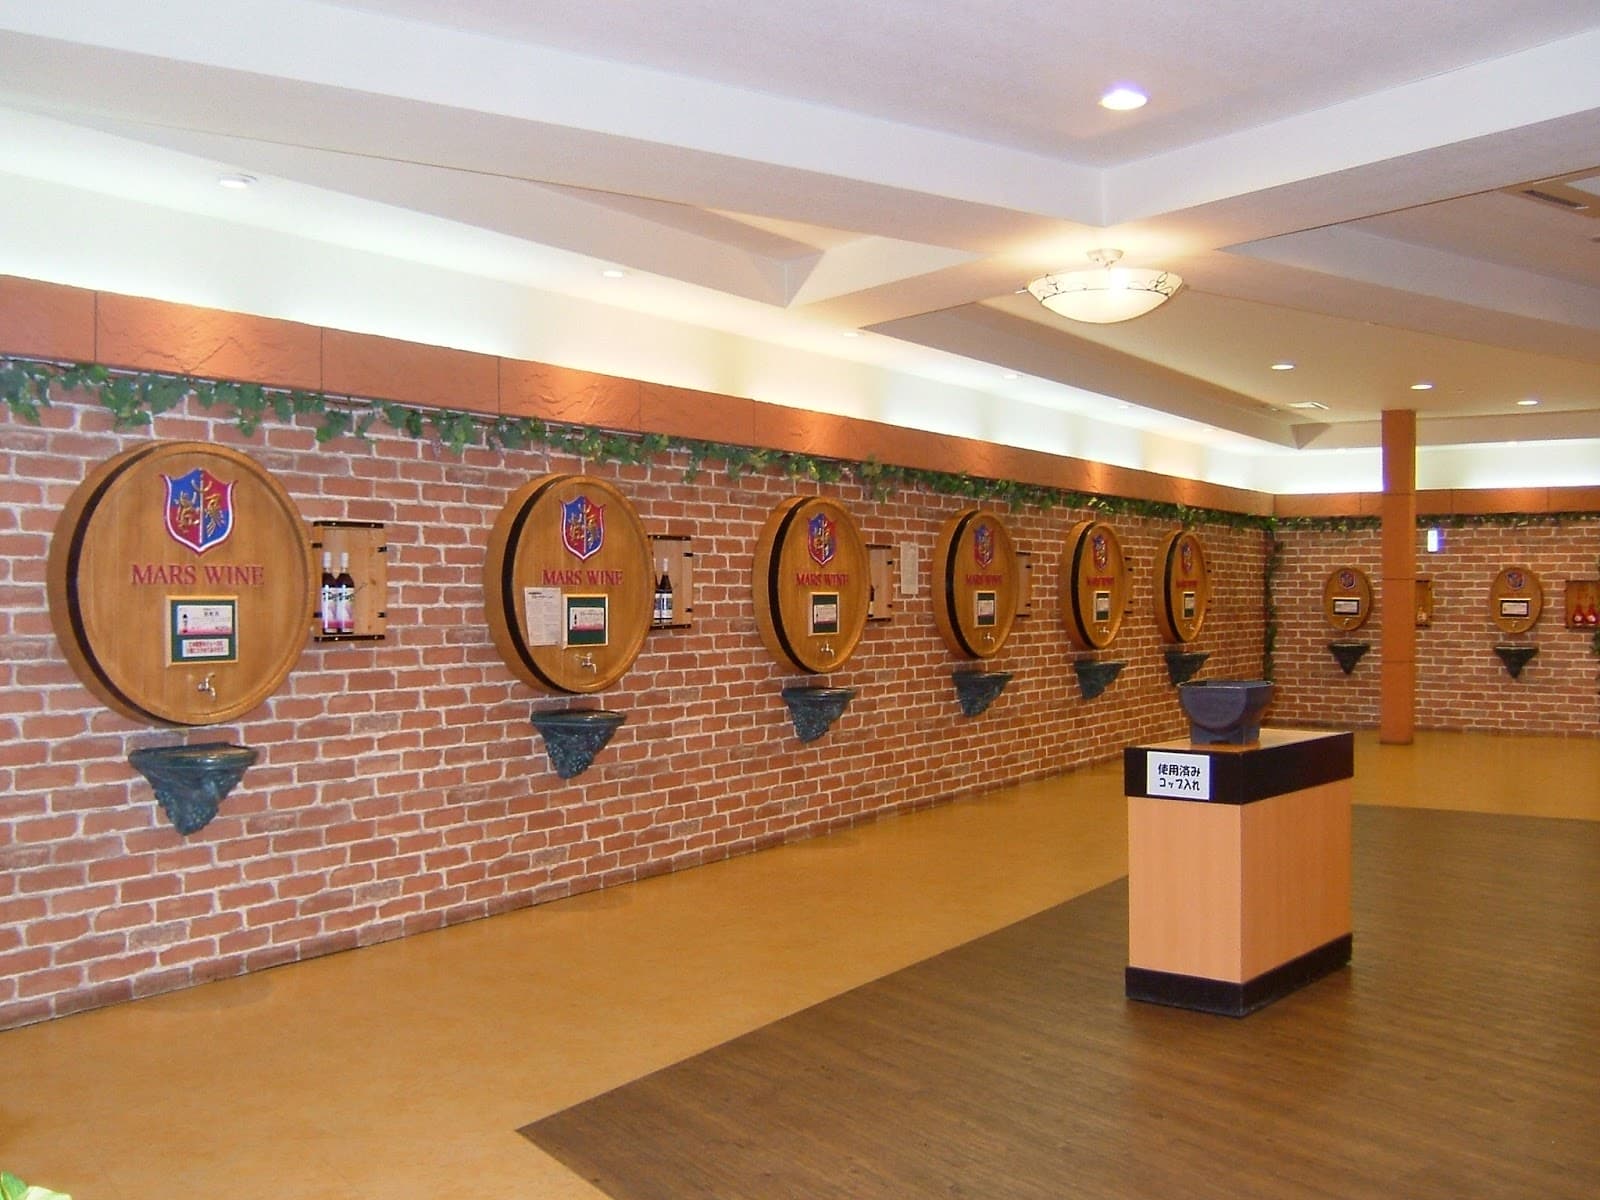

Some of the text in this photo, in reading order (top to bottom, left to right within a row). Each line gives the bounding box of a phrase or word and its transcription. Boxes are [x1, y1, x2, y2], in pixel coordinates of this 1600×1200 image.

[131, 563, 265, 587] MARS WINE
[542, 568, 624, 587] MARS WINE
[1158, 763, 1201, 777] 使用済み
[1159, 777, 1201, 791] コップ入れ
